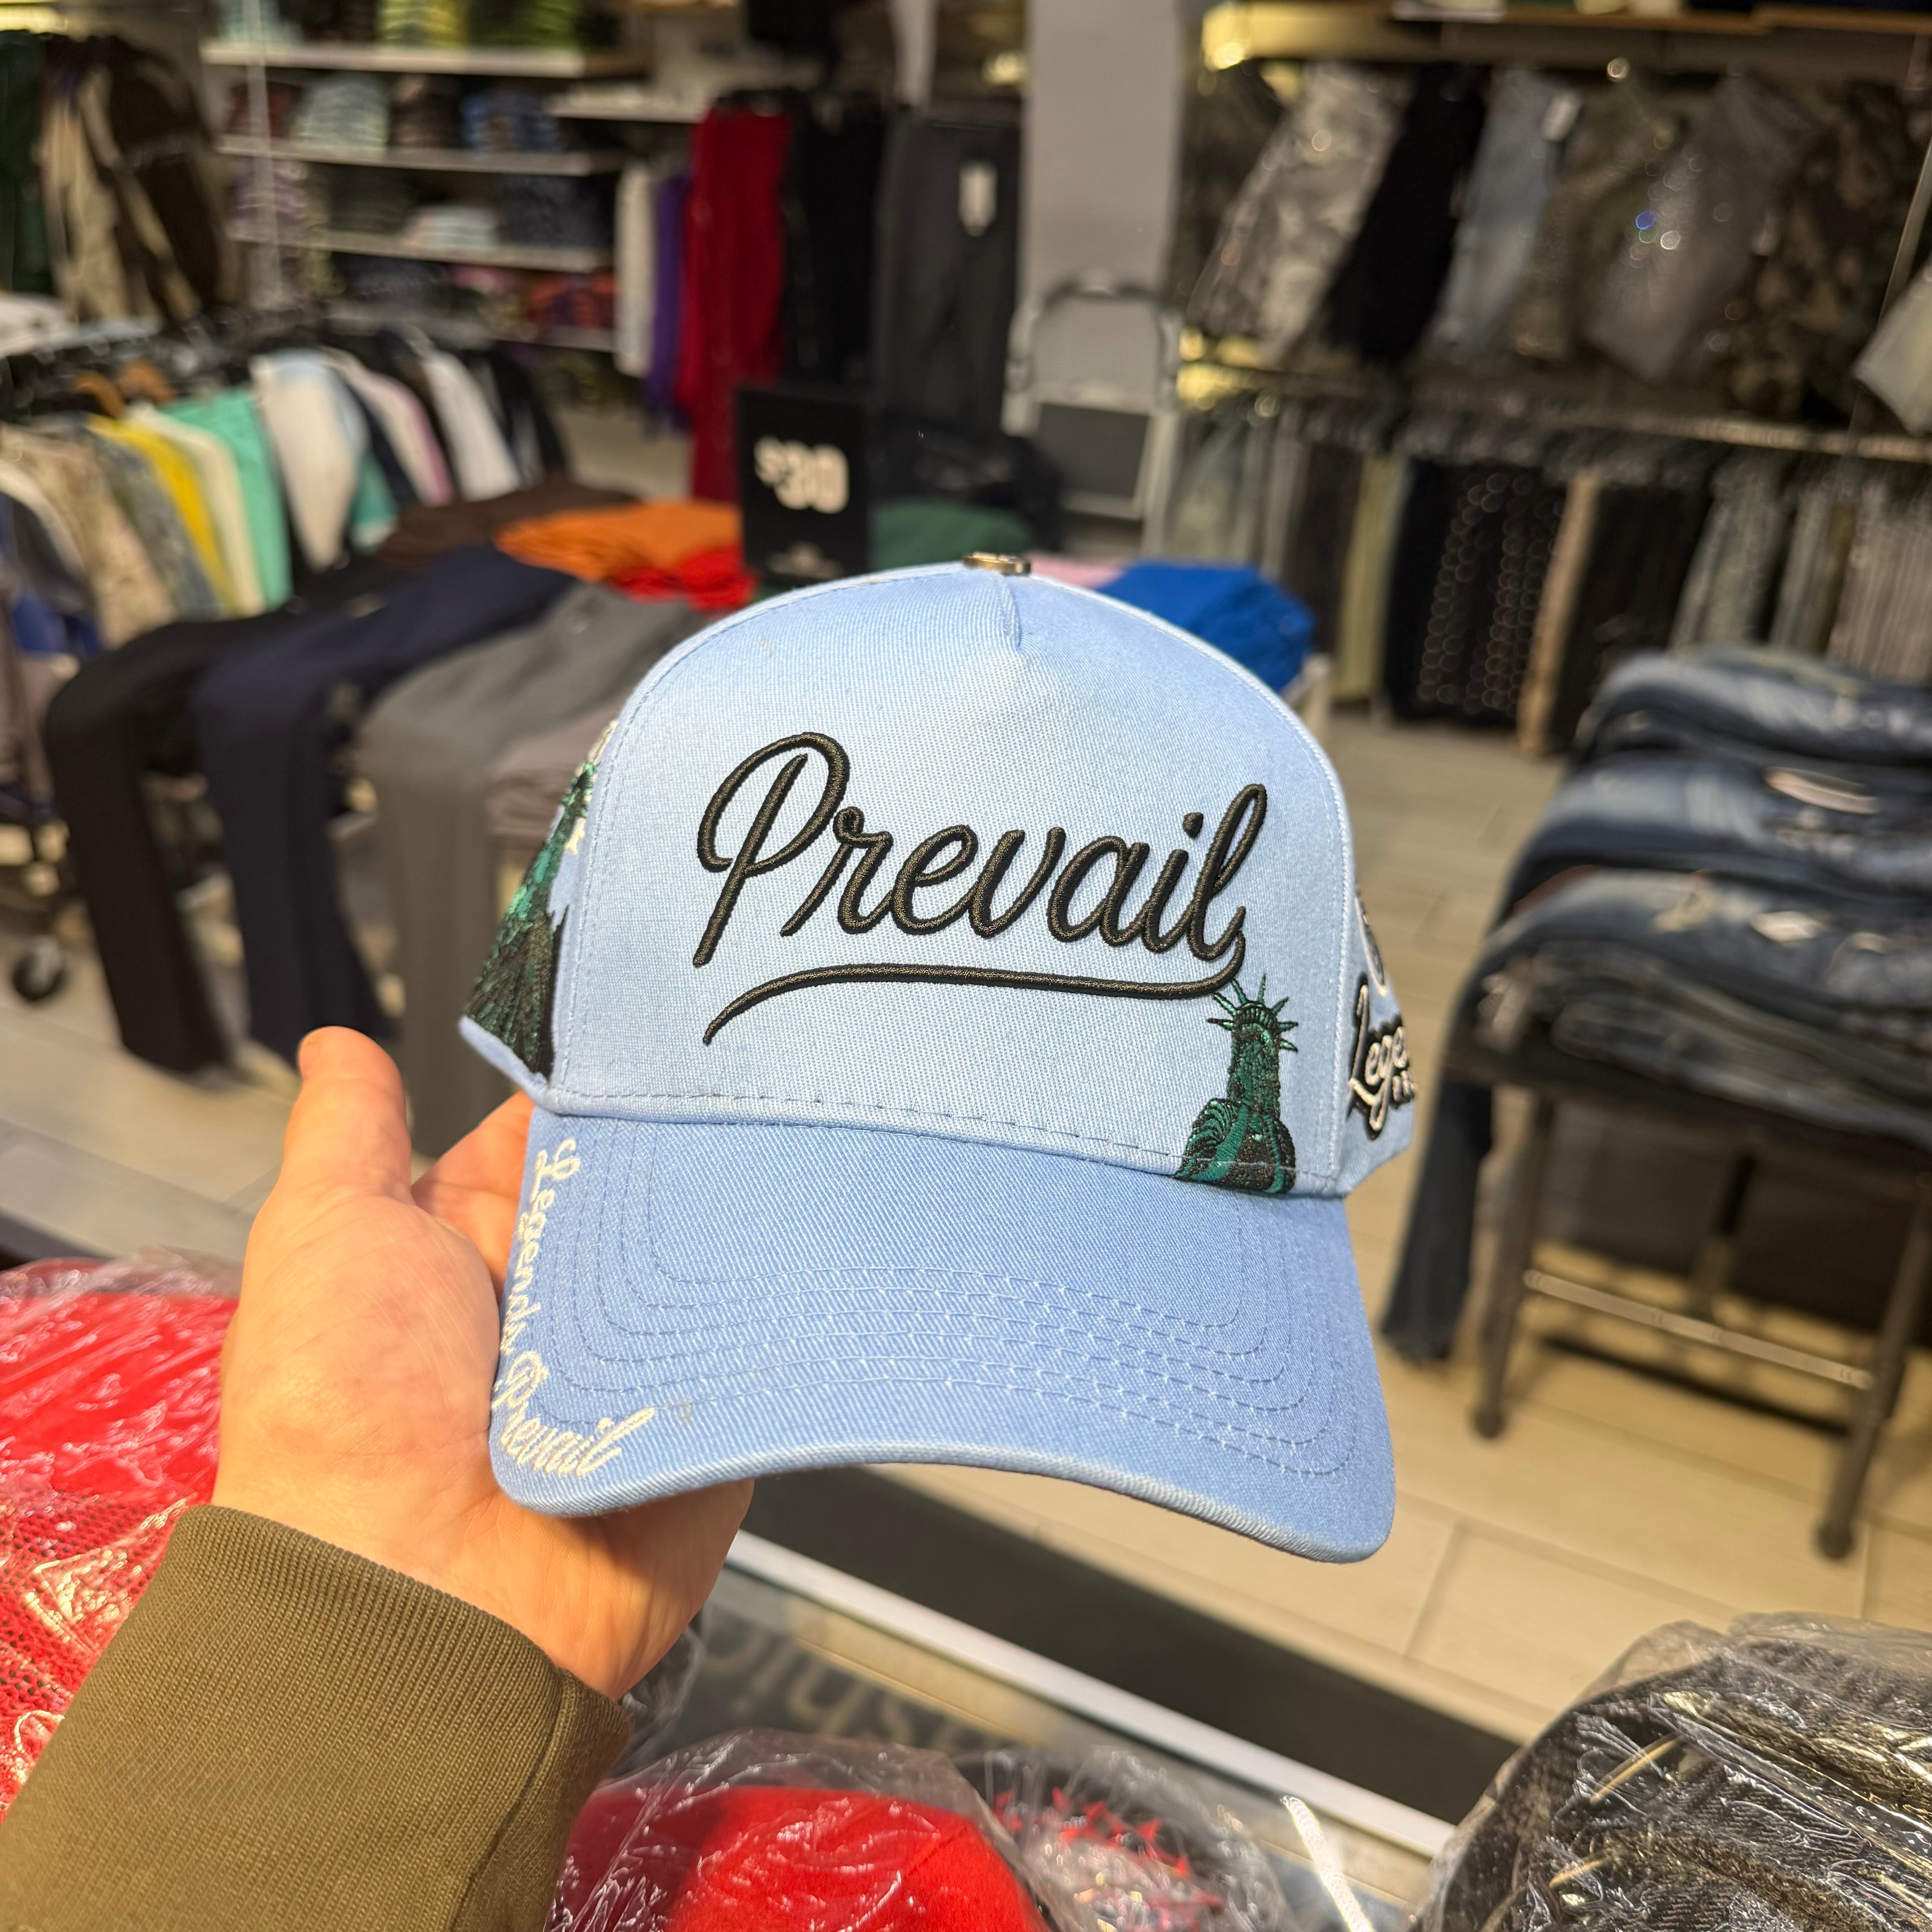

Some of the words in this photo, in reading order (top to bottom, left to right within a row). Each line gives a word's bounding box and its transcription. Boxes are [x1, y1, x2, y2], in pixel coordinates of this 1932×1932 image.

[692, 731, 1268, 968] Prevail
[499, 1138, 580, 1353] Legends
[491, 1349, 656, 1477] Prevail
